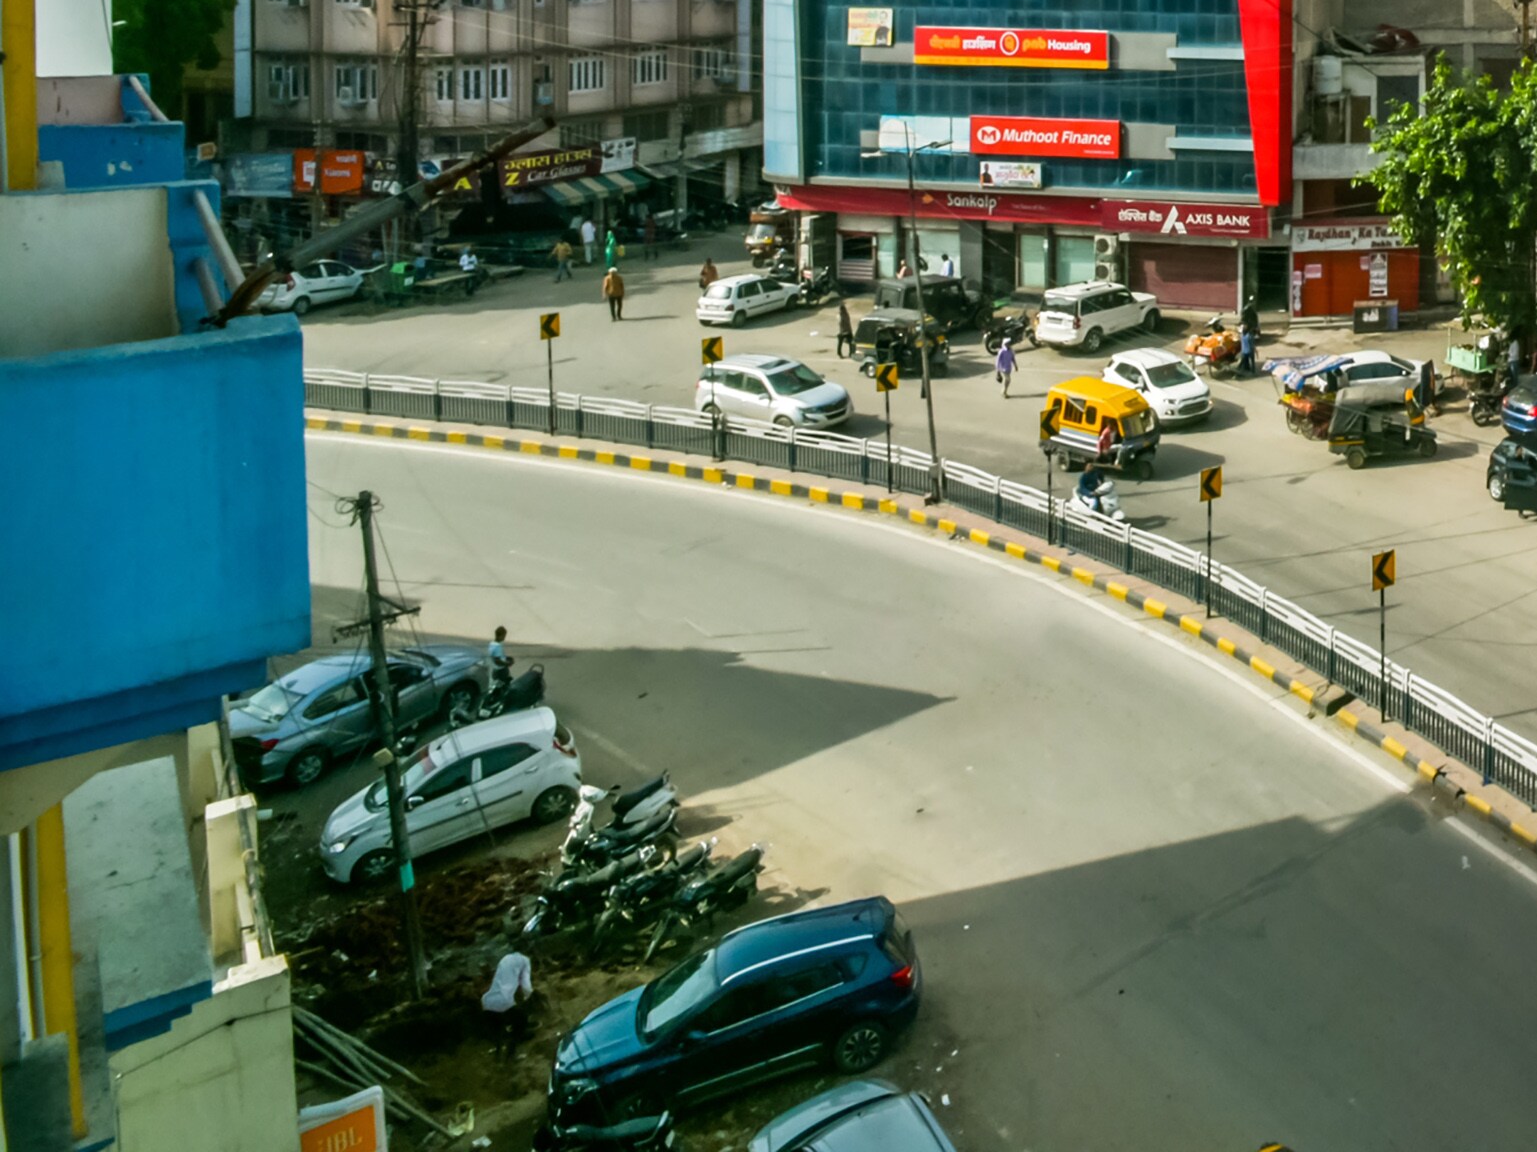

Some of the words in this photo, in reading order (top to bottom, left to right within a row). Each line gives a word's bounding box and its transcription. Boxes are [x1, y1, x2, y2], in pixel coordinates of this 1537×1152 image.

[1047, 39, 1091, 54] Housing
[1002, 128, 1058, 144] Muthoot
[1061, 130, 1112, 146] Finance
[453, 176, 473, 191] A
[504, 171, 520, 186] Z
[947, 193, 997, 216] Sankalp
[1185, 212, 1213, 225] AXIS
[1216, 214, 1251, 227] BANK
